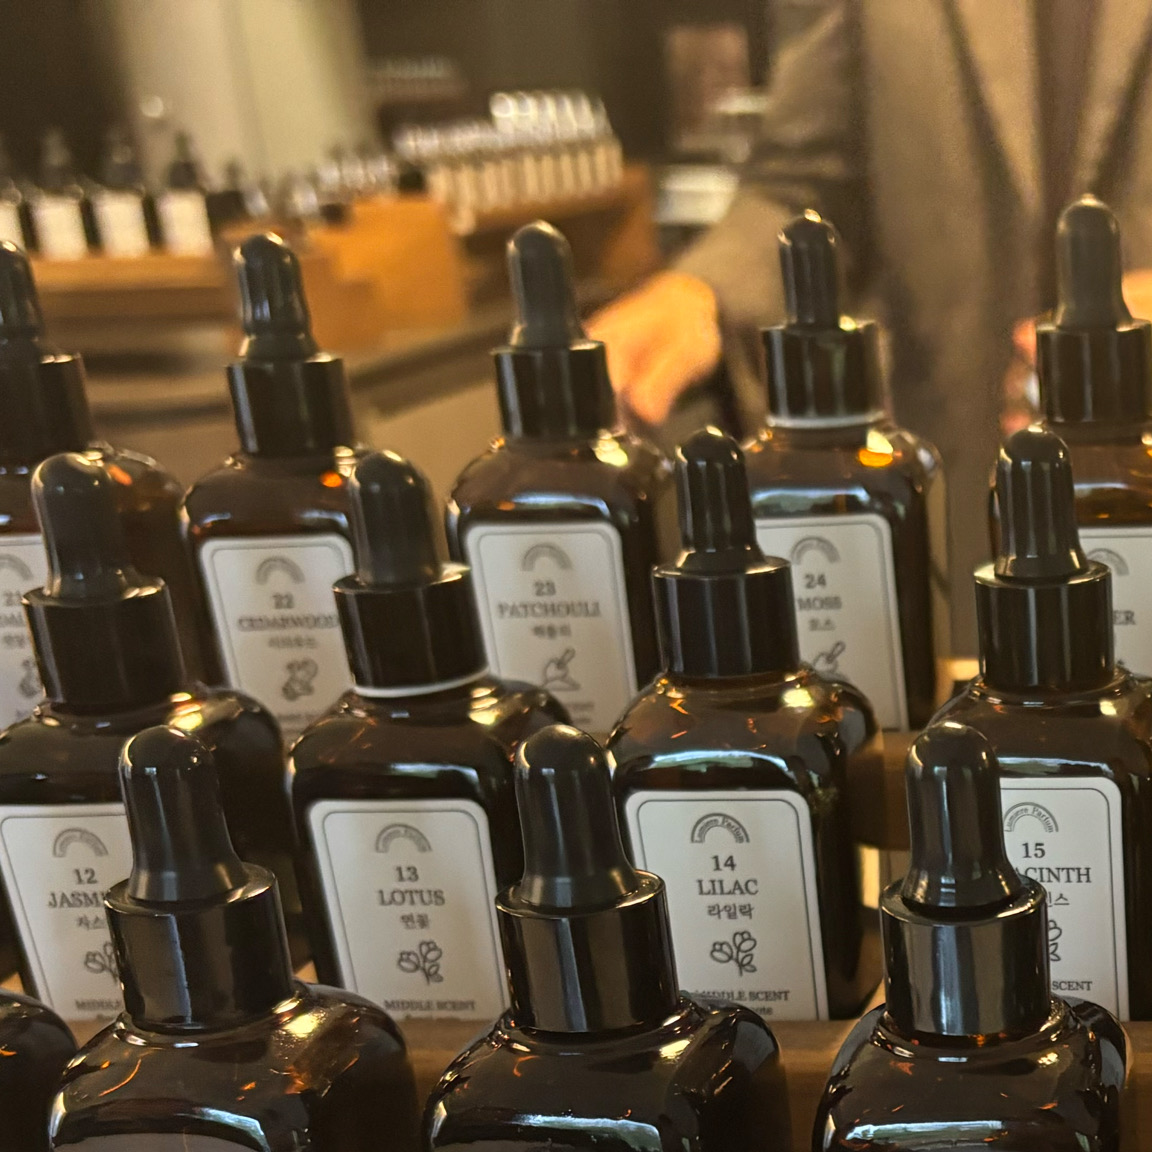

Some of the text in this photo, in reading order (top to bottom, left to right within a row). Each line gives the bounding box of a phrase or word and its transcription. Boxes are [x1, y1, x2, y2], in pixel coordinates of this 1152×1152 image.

[1022, 842, 1046, 859] 15
[711, 855, 737, 871] 14
[73, 868, 98, 884] 12
[395, 866, 419, 882] 13
[1016, 867, 1092, 884] CINTH
[696, 879, 759, 896] LILAC
[48, 892, 107, 909] JASM
[377, 889, 446, 907] LOTUS
[707, 903, 754, 920] 라일락
[1052, 981, 1093, 991] SCENT
[749, 990, 790, 1001] SCENT
